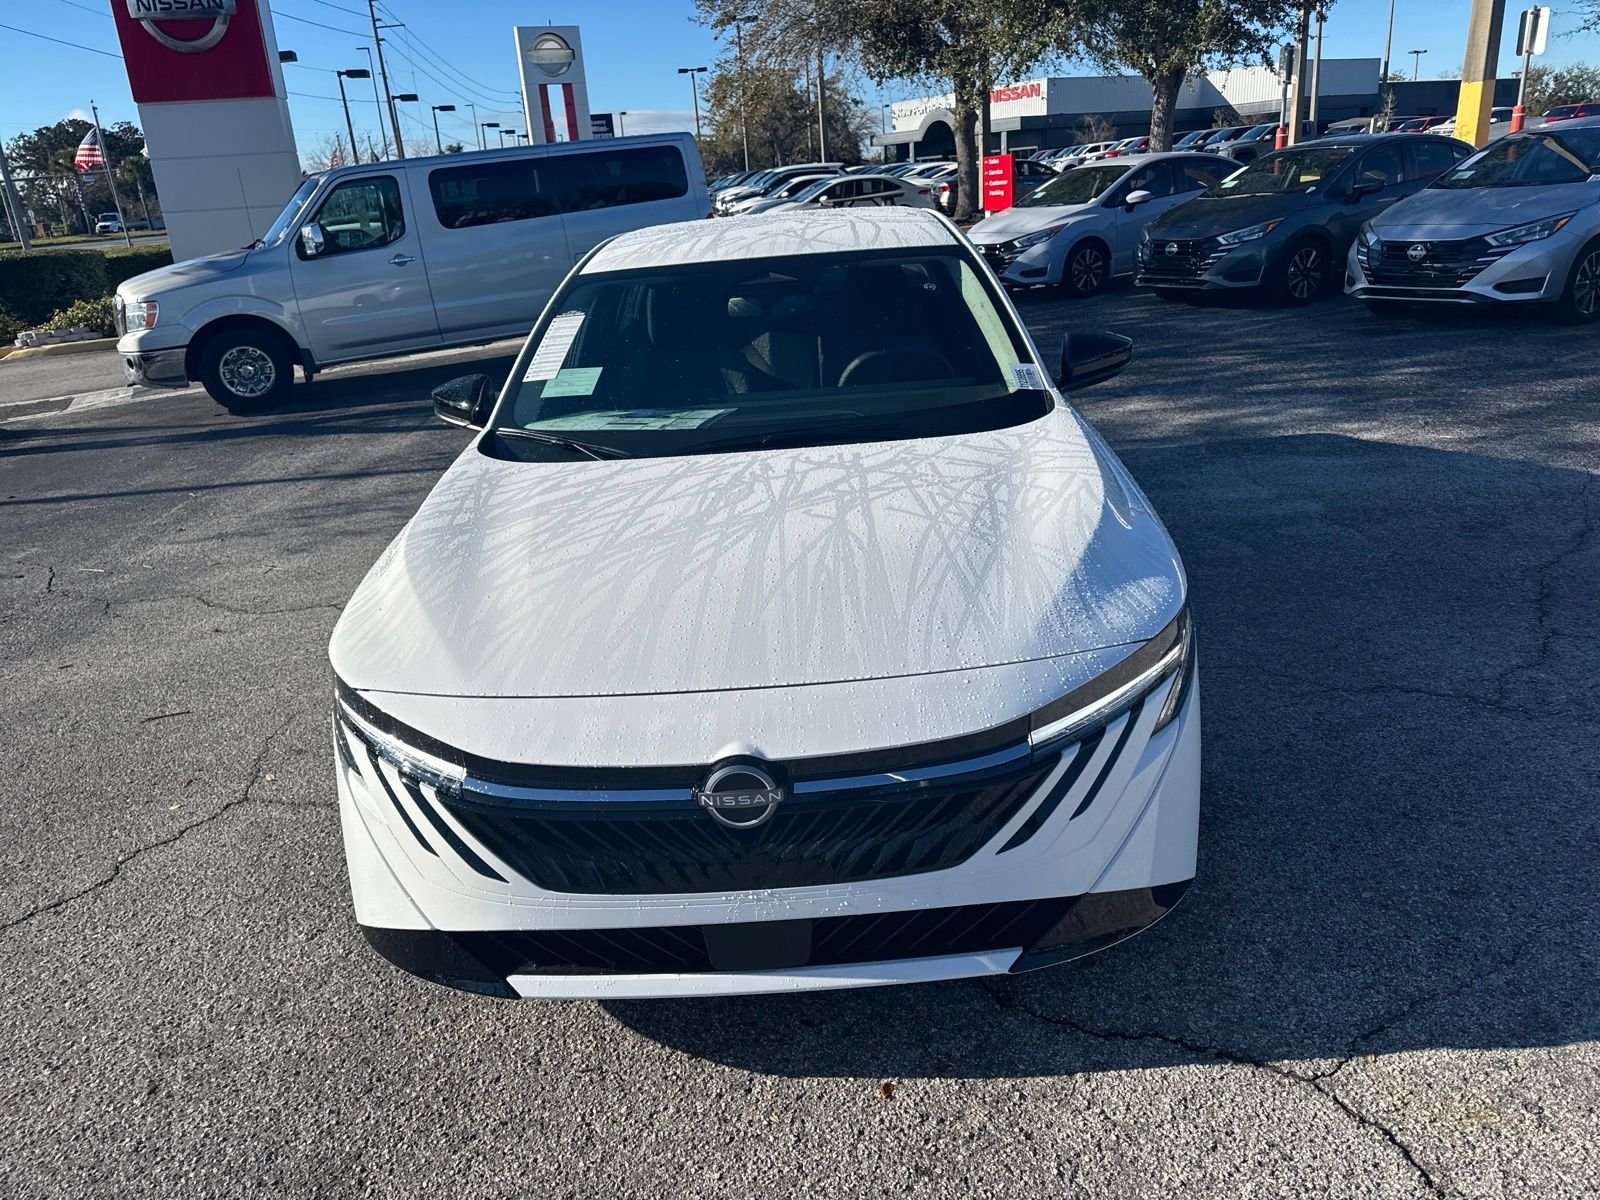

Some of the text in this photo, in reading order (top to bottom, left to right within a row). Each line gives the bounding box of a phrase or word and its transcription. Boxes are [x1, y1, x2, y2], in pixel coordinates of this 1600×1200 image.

[136, 0, 225, 12] NISSAN
[991, 83, 1041, 103] NISSAN
[989, 168, 1004, 176] Service
[989, 179, 1008, 187] Customer
[988, 189, 1005, 197] Parking
[701, 791, 781, 806] NISSAN
